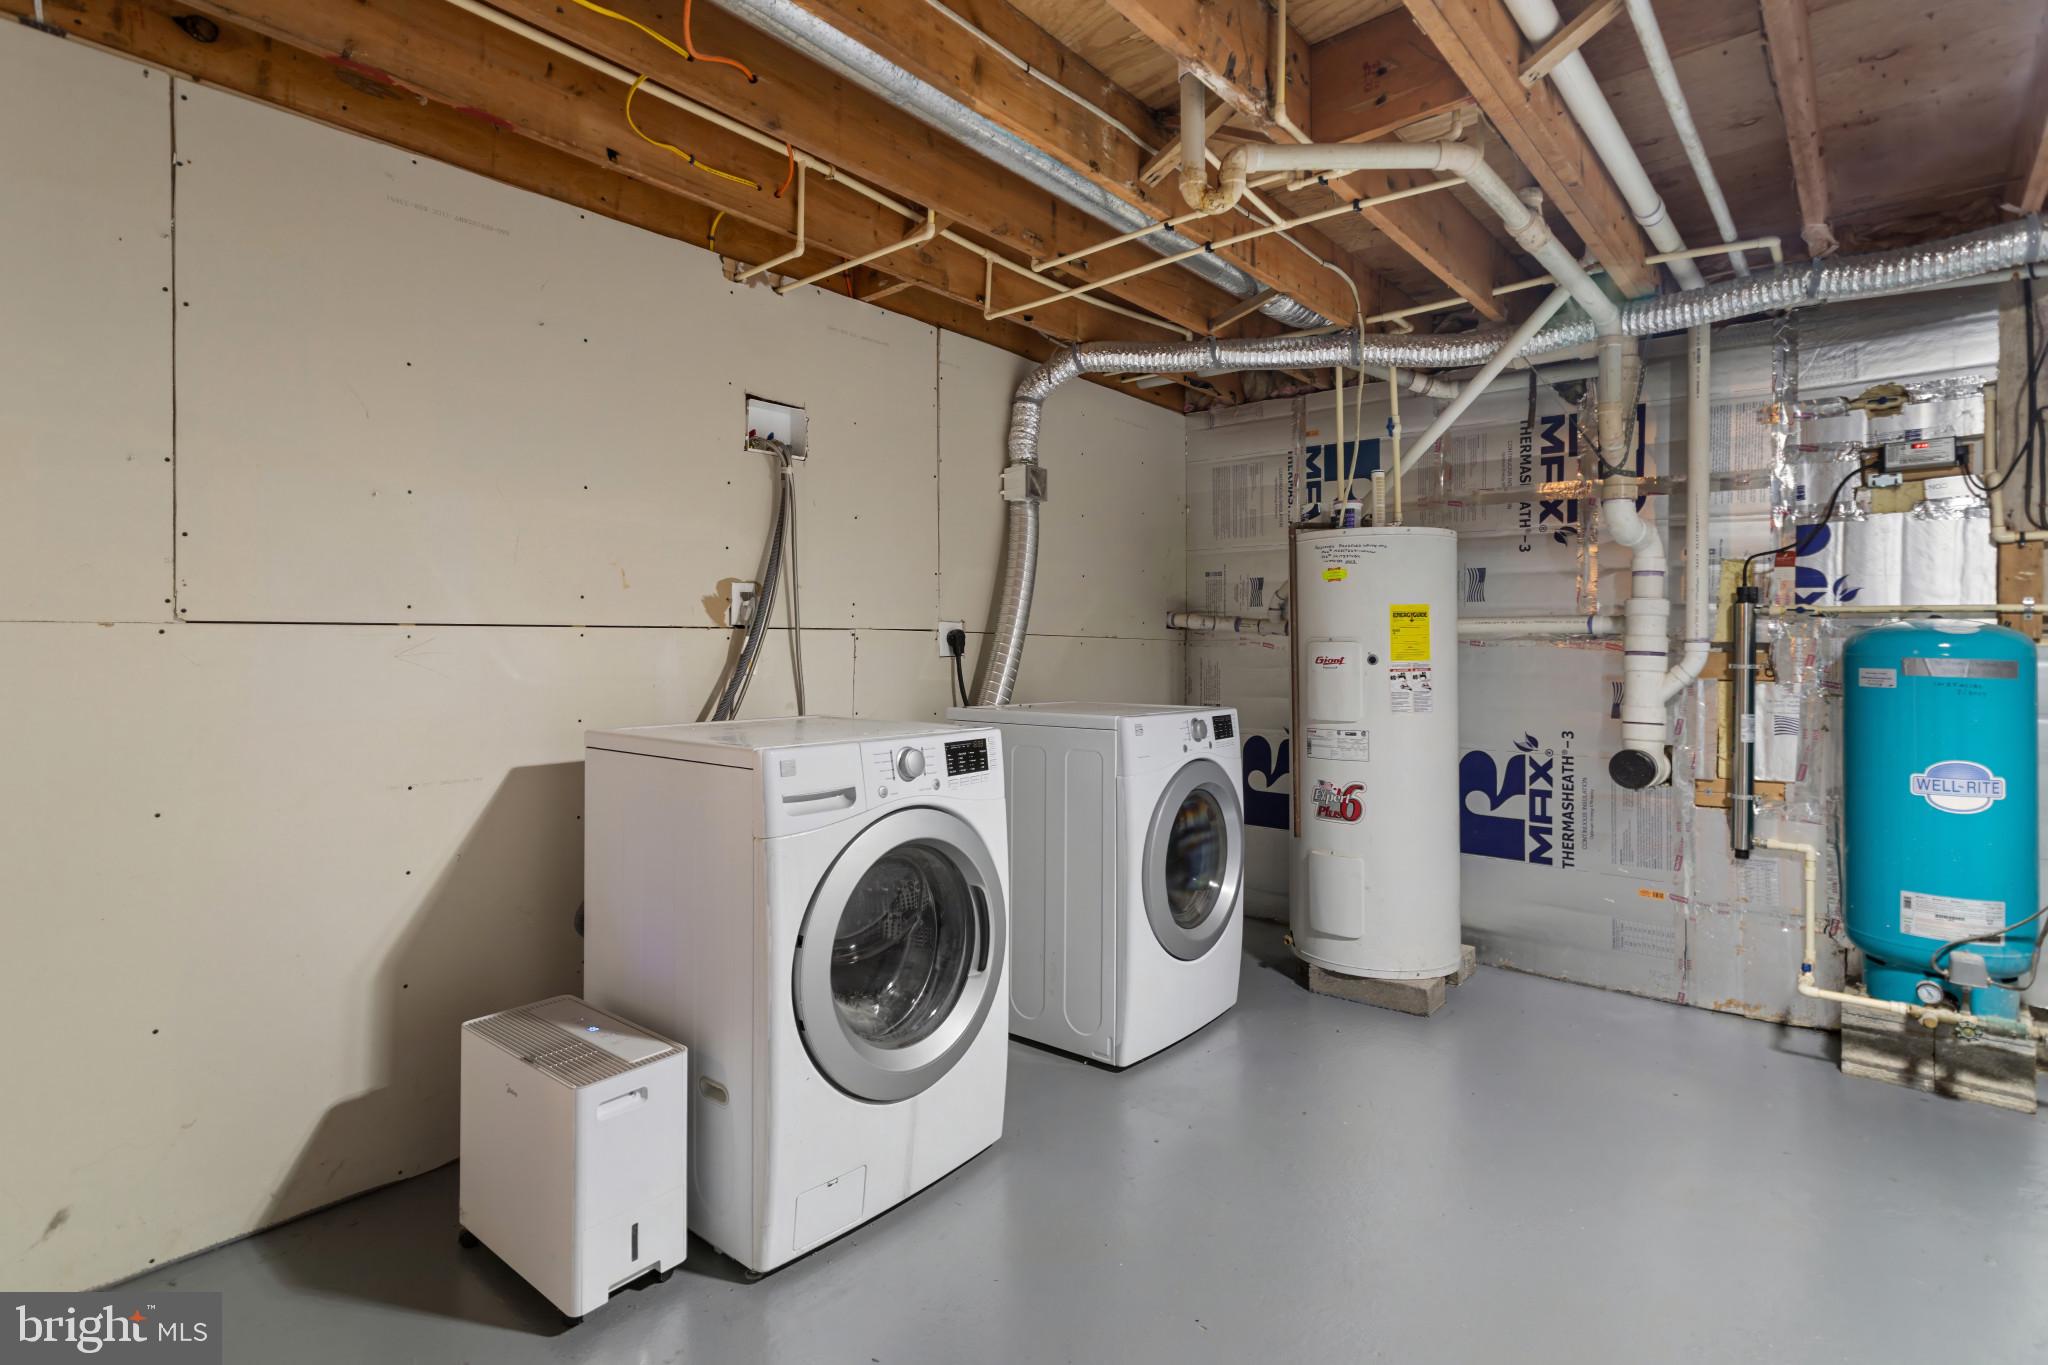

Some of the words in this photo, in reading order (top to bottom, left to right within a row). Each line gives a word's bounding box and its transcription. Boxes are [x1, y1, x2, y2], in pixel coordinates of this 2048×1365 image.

[1315, 656, 1345, 665] Giant
[1916, 778, 2000, 795] WELL-RITE
[1317, 805, 1342, 819] Plus
[1340, 784, 1364, 822] 6
